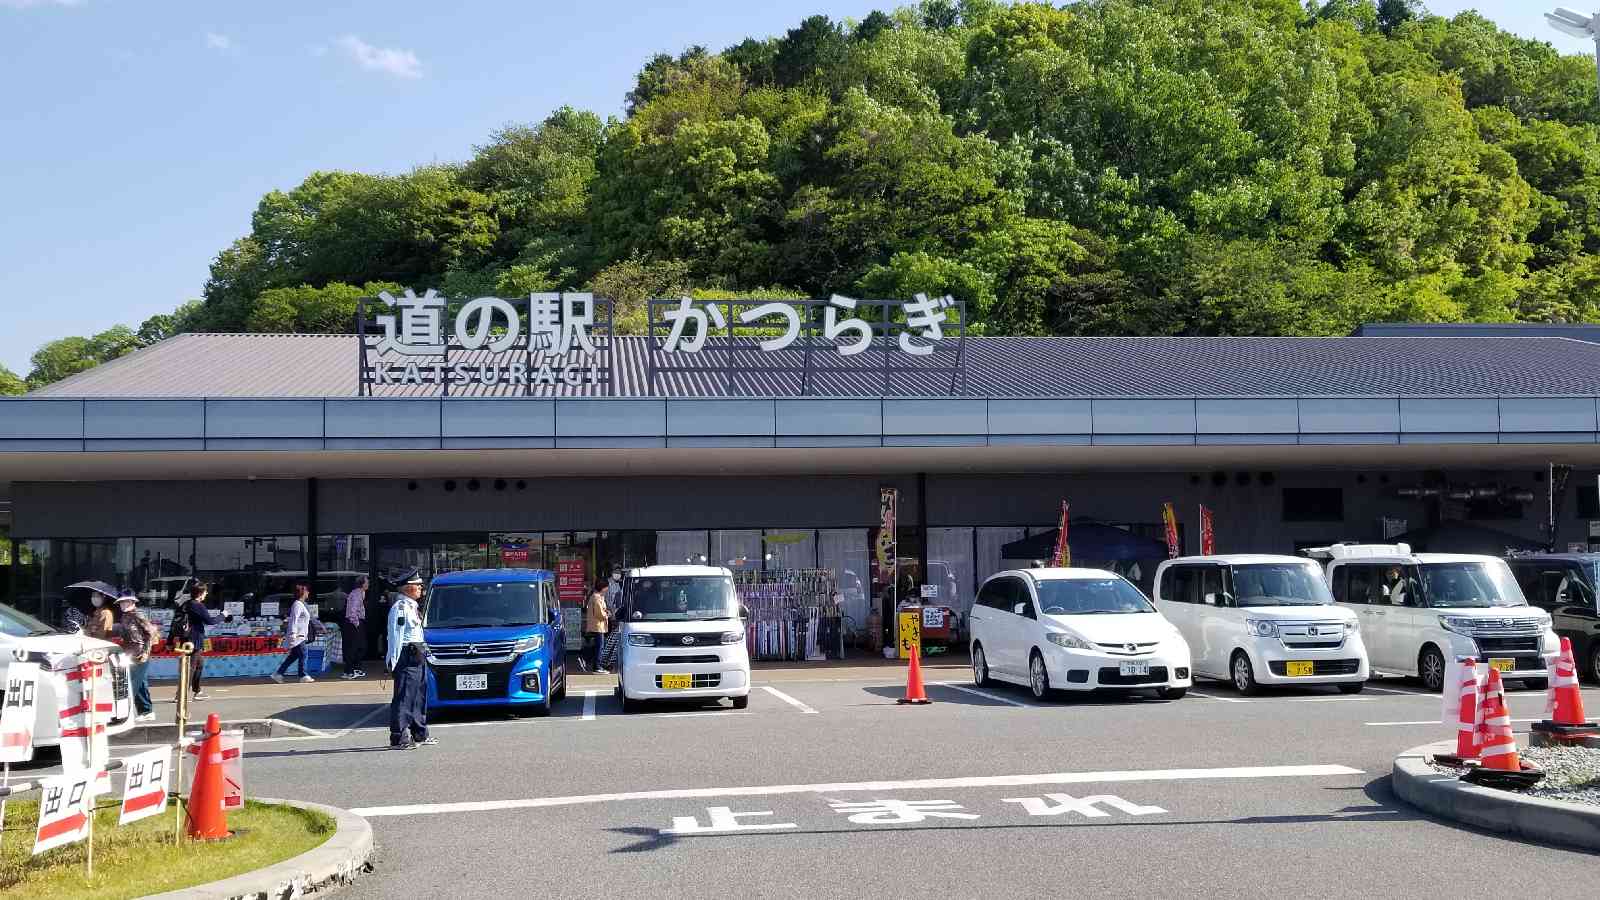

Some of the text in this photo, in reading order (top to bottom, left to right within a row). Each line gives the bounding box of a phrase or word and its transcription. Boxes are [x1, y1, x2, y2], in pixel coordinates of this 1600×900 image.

[375, 289, 955, 358] 道の駅 かつらぎ
[374, 362, 599, 385] KATSURAGI
[6, 678, 35, 707] 出口
[129, 759, 164, 789] 出口
[45, 781, 87, 815] 出口
[659, 793, 1169, 834] 止まれ
